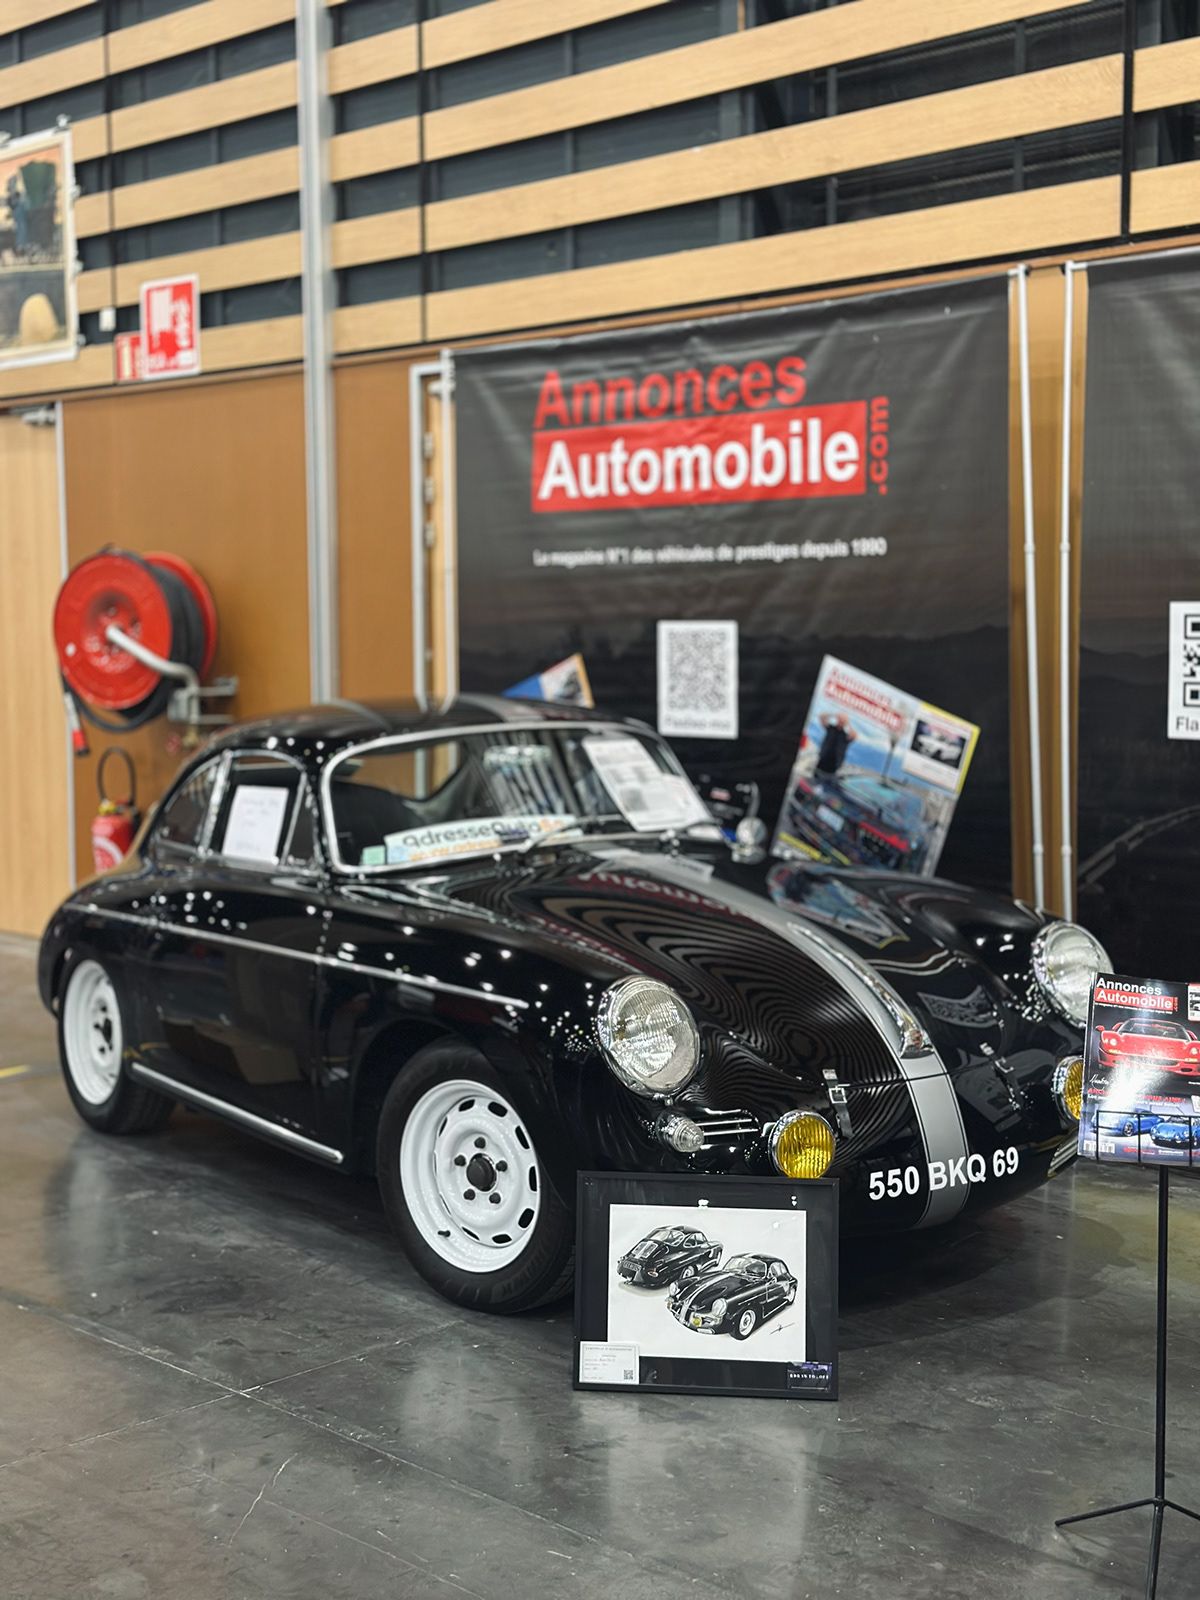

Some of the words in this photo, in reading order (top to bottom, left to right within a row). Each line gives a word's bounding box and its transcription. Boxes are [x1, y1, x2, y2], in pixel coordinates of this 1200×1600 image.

[533, 356, 808, 429] Annonces
[538, 417, 860, 501] Automobile
[870, 395, 889, 495] .com
[1096, 977, 1162, 996] Annonces
[1097, 990, 1173, 1010] Automobile
[869, 1165, 920, 1201] 550
[928, 1153, 987, 1191] BKQ
[992, 1146, 1019, 1178] 69
